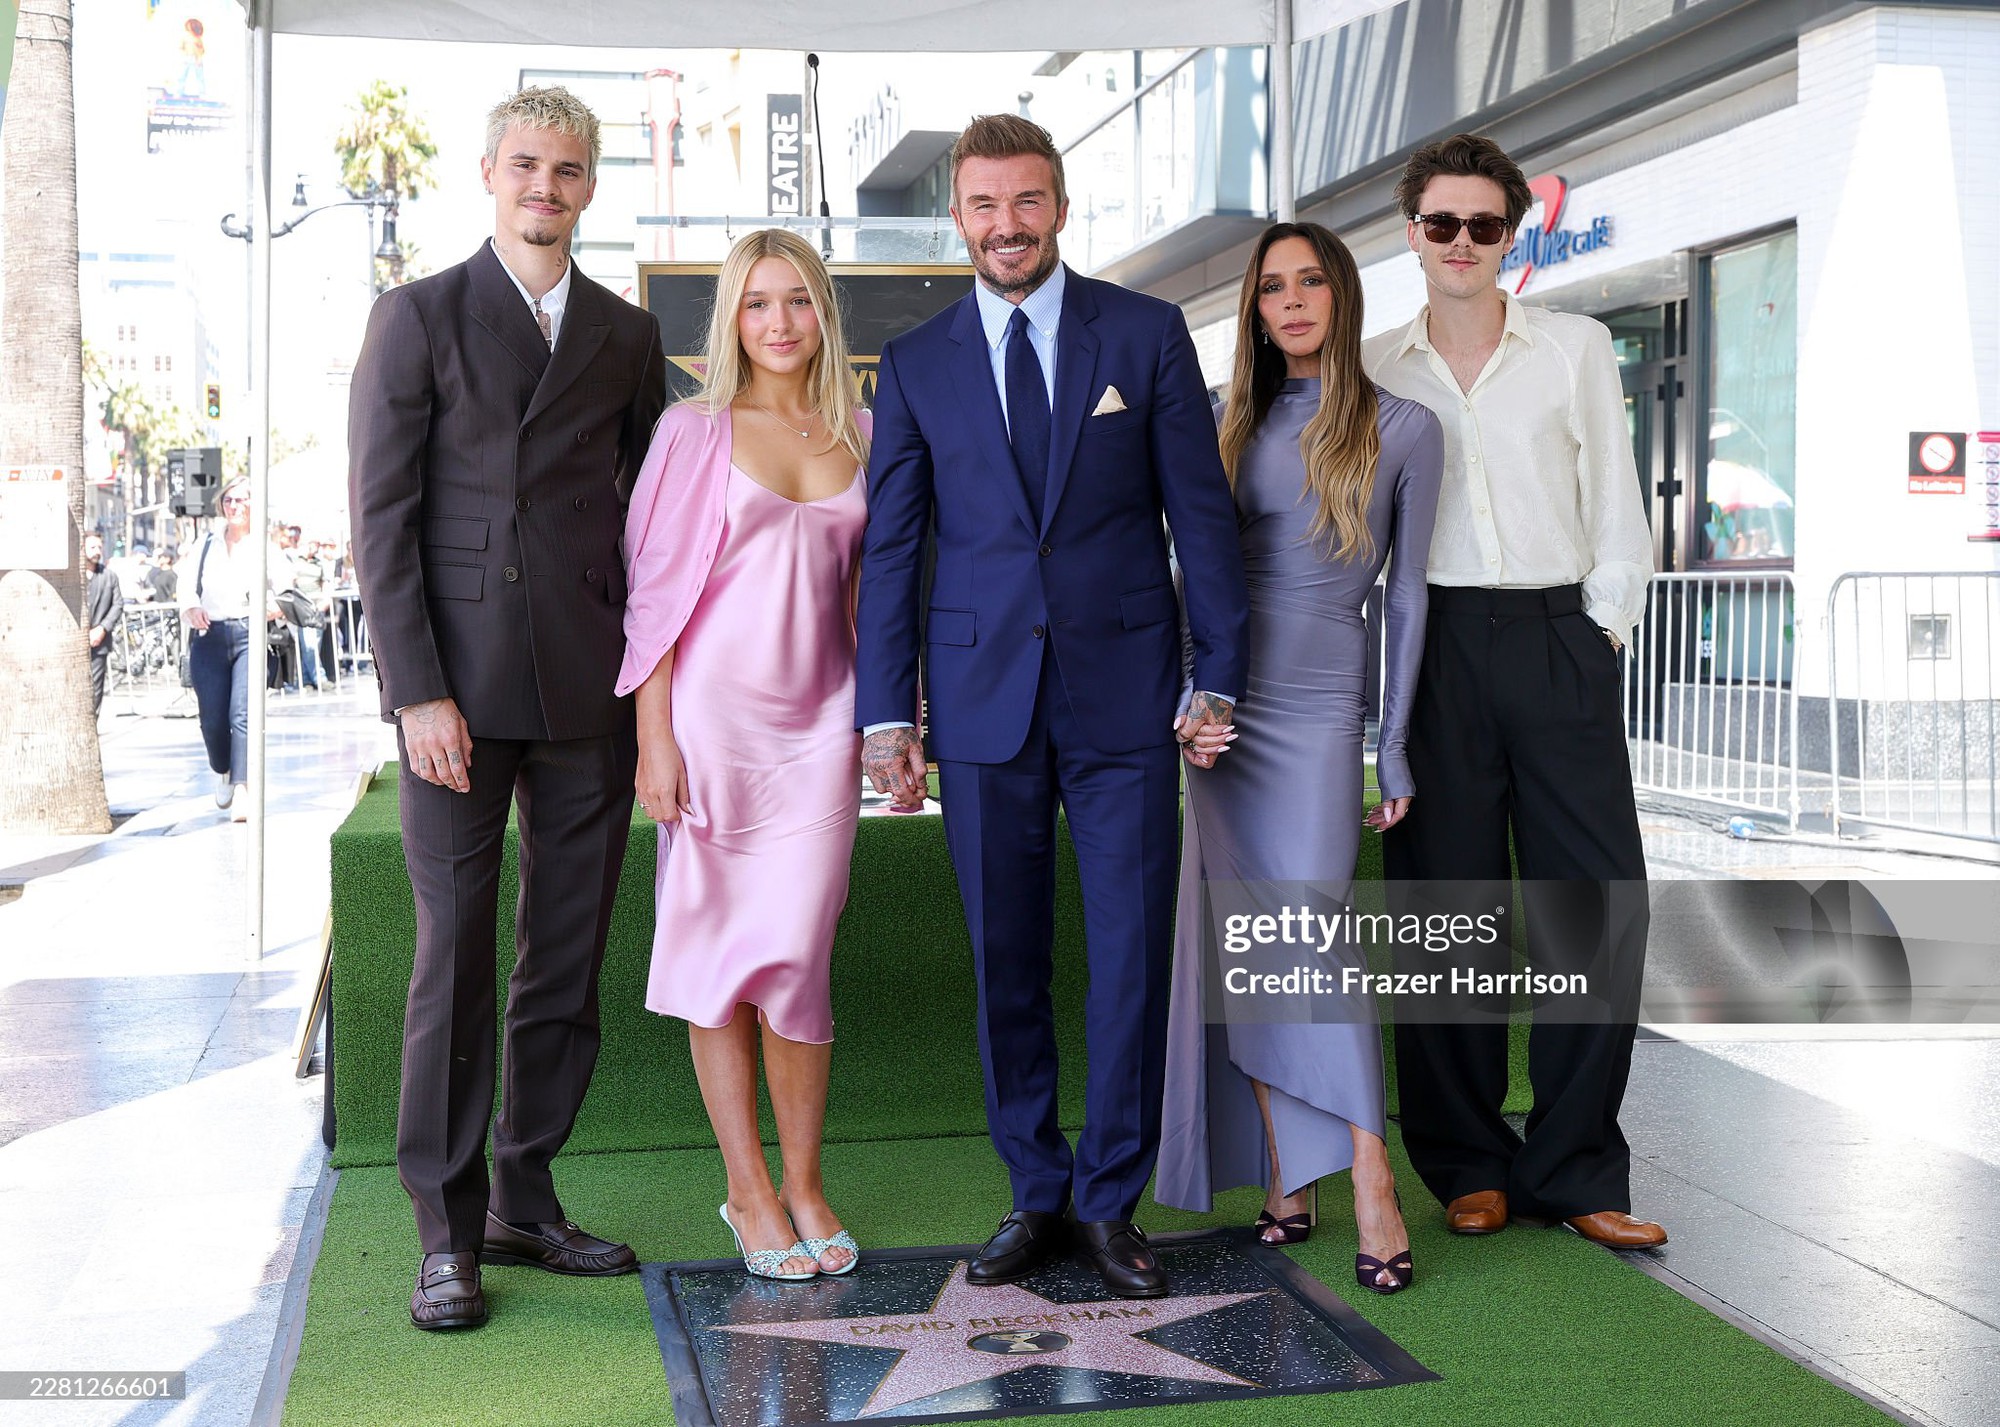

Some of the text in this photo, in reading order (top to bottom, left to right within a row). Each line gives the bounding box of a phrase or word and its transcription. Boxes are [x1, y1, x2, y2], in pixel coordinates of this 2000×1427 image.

[771, 111, 799, 216] EATRE
[849, 1307, 1153, 1336] DAVID BECKHAM
